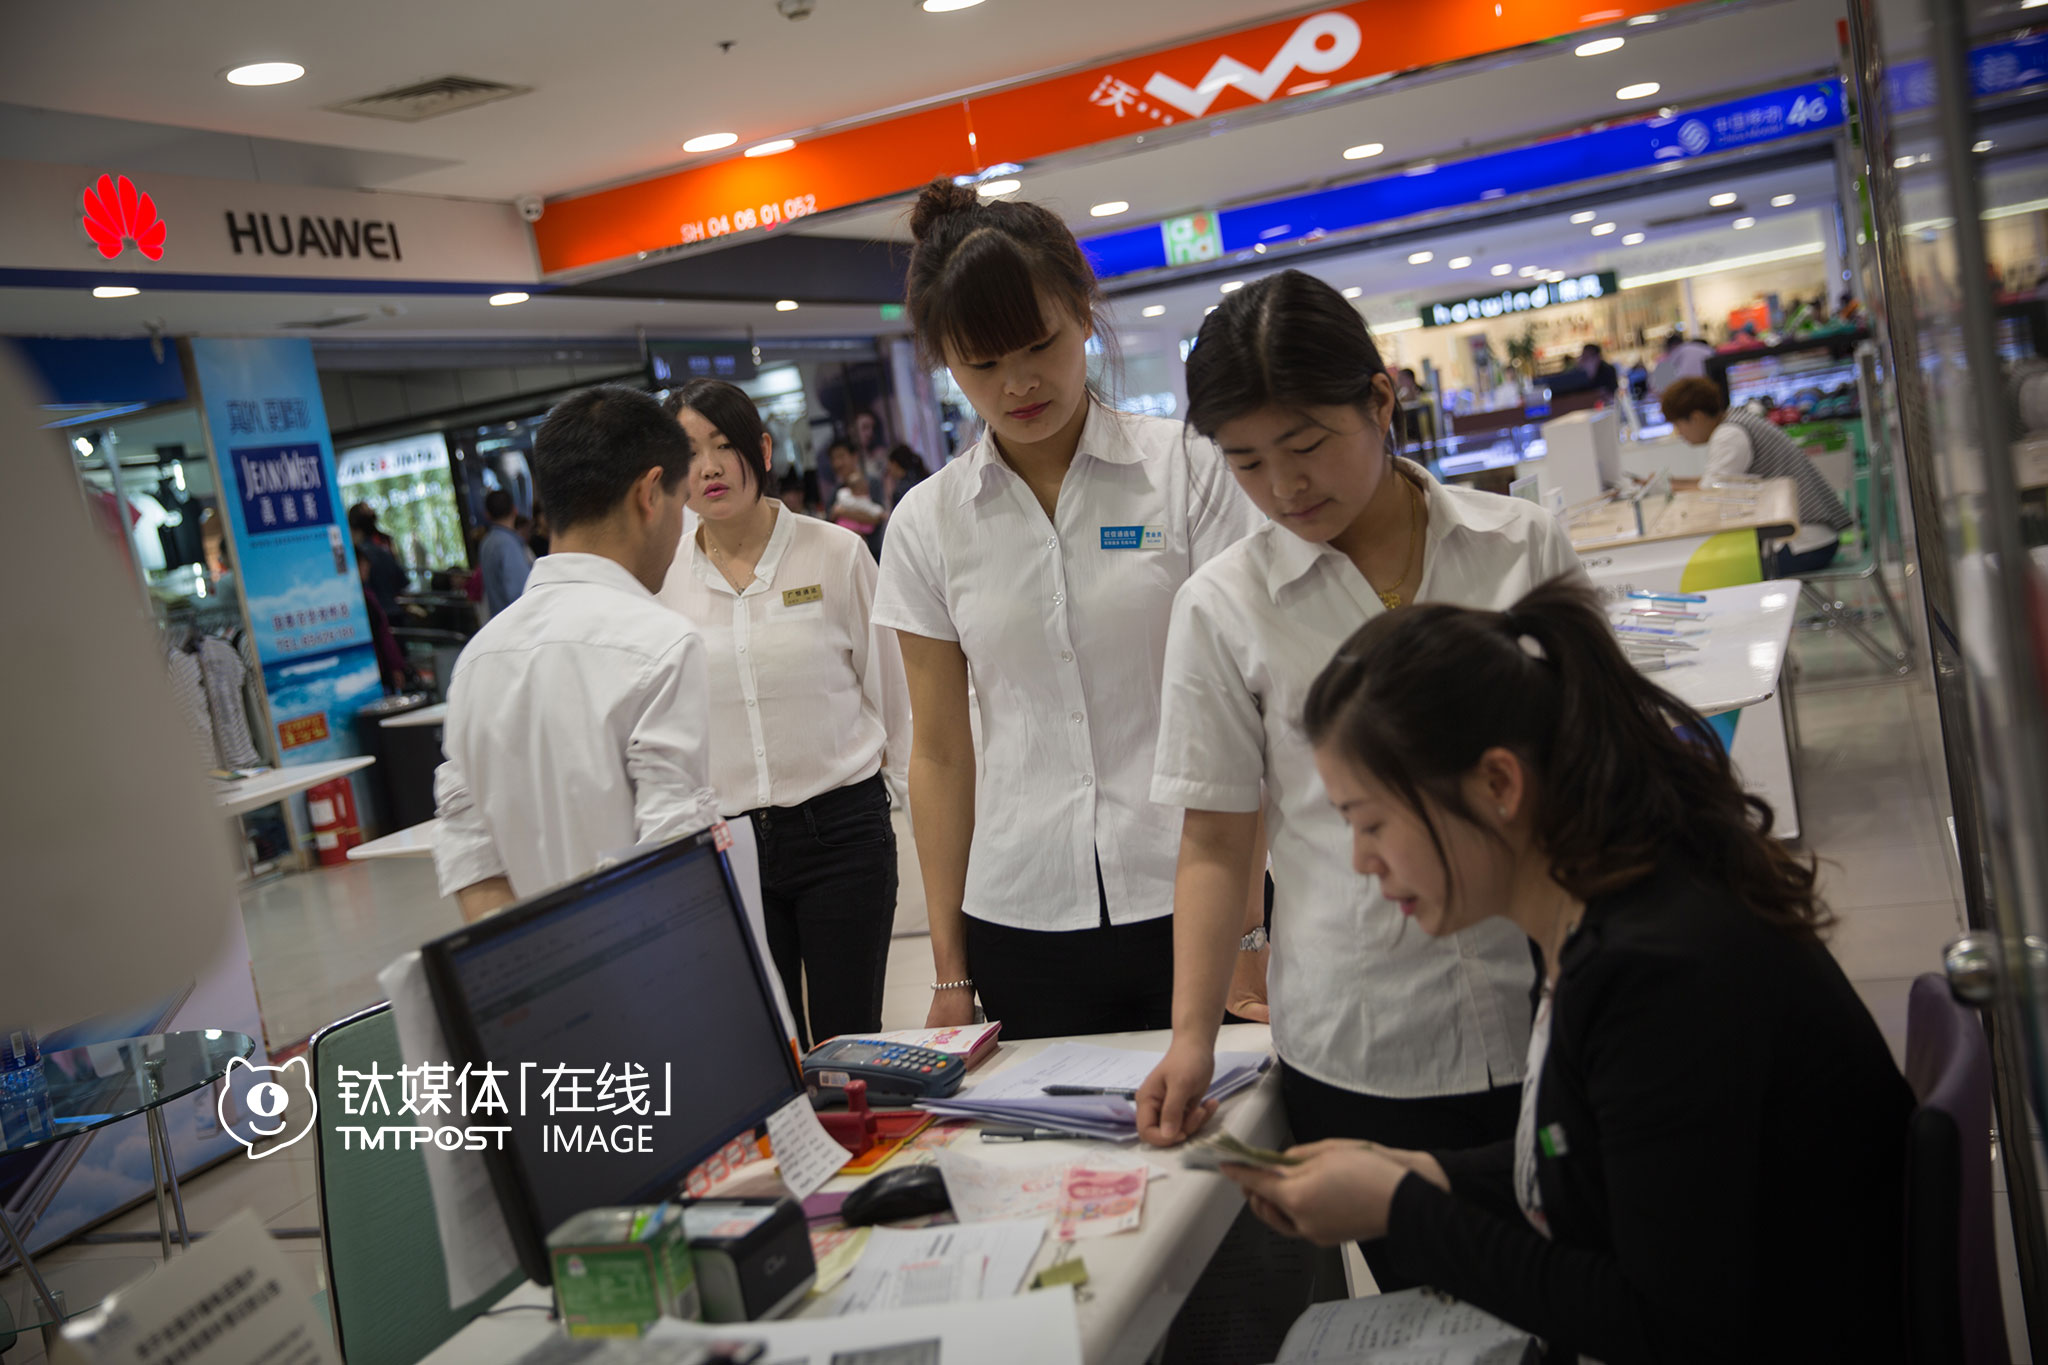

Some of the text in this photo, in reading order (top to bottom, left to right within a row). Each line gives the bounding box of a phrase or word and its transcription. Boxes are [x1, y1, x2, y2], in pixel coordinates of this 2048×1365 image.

[225, 210, 403, 262] HUAWEI
[707, 214, 731, 237] 04
[760, 202, 782, 225] 01
[1432, 282, 1550, 327] hotwind
